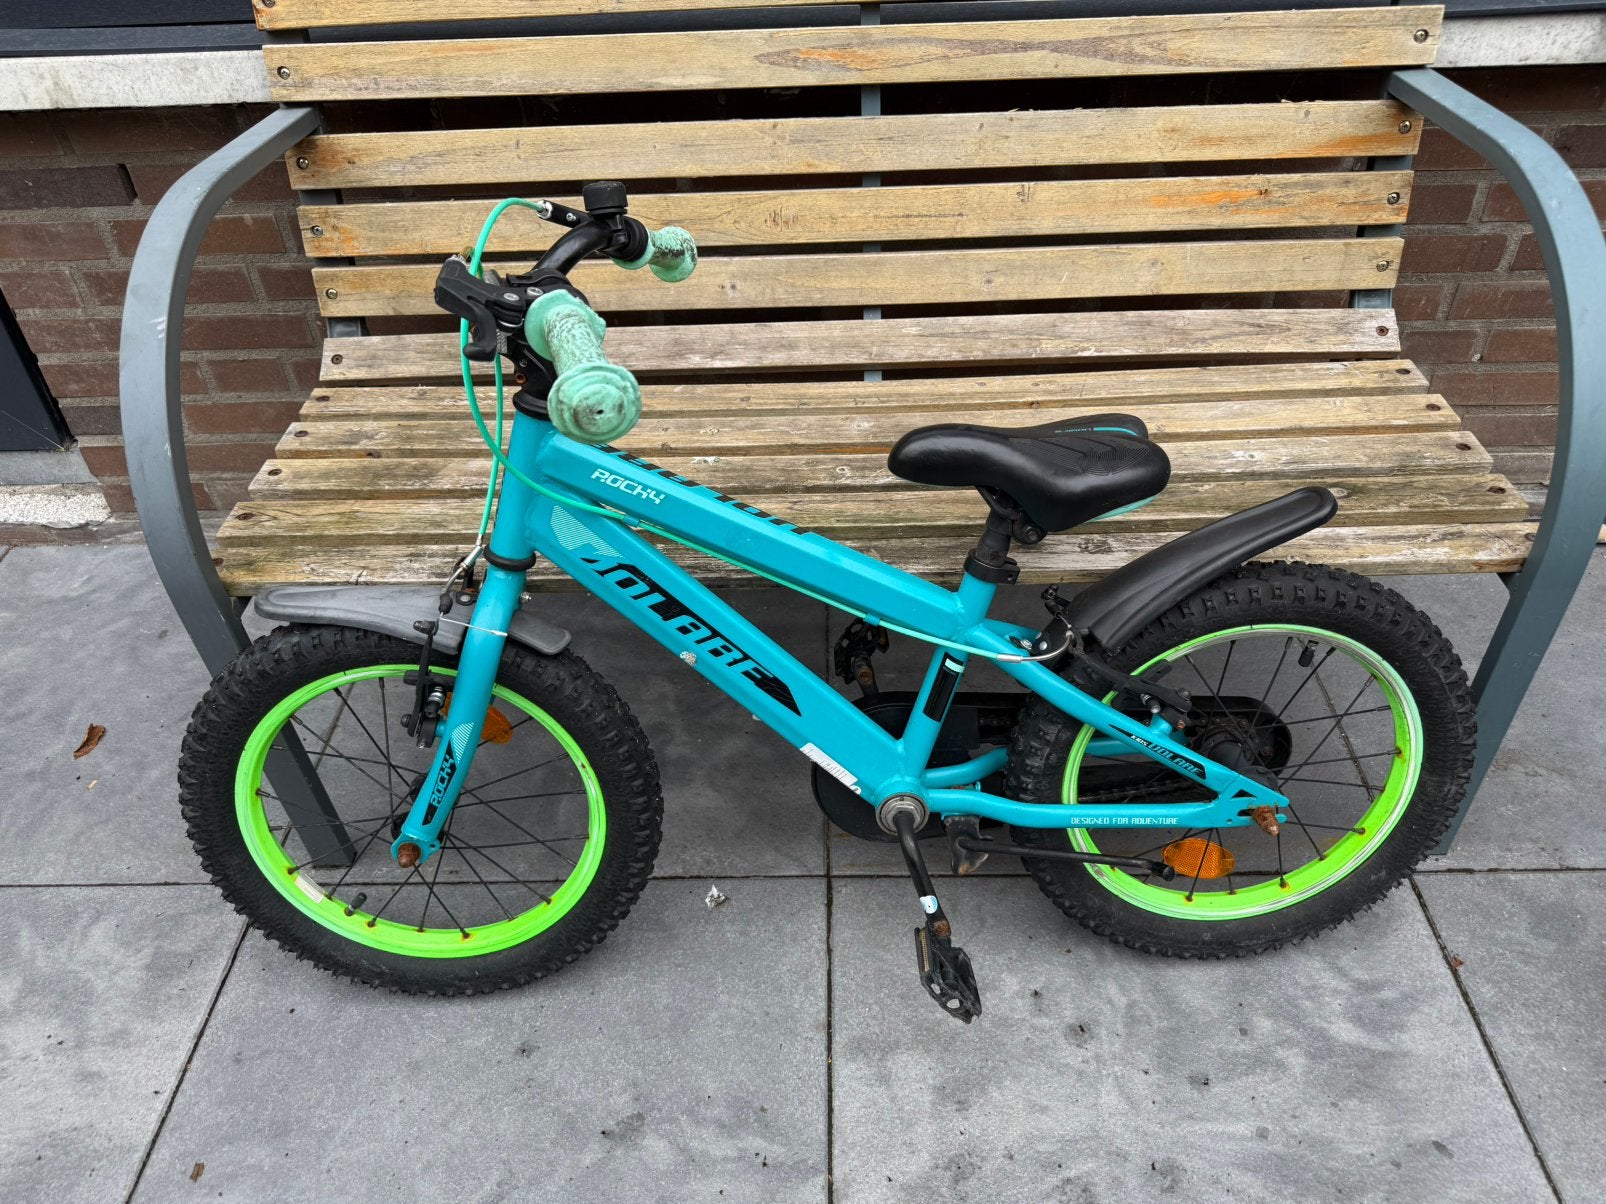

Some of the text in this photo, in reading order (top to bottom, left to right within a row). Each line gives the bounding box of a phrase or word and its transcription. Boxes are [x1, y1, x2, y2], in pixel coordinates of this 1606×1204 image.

[590, 468, 666, 505] ROCKY
[1148, 742, 1203, 775] VOLARE
[430, 756, 454, 807] ROCKY
[1070, 816, 1179, 825] DESIGNED FOR ADVENTURE
